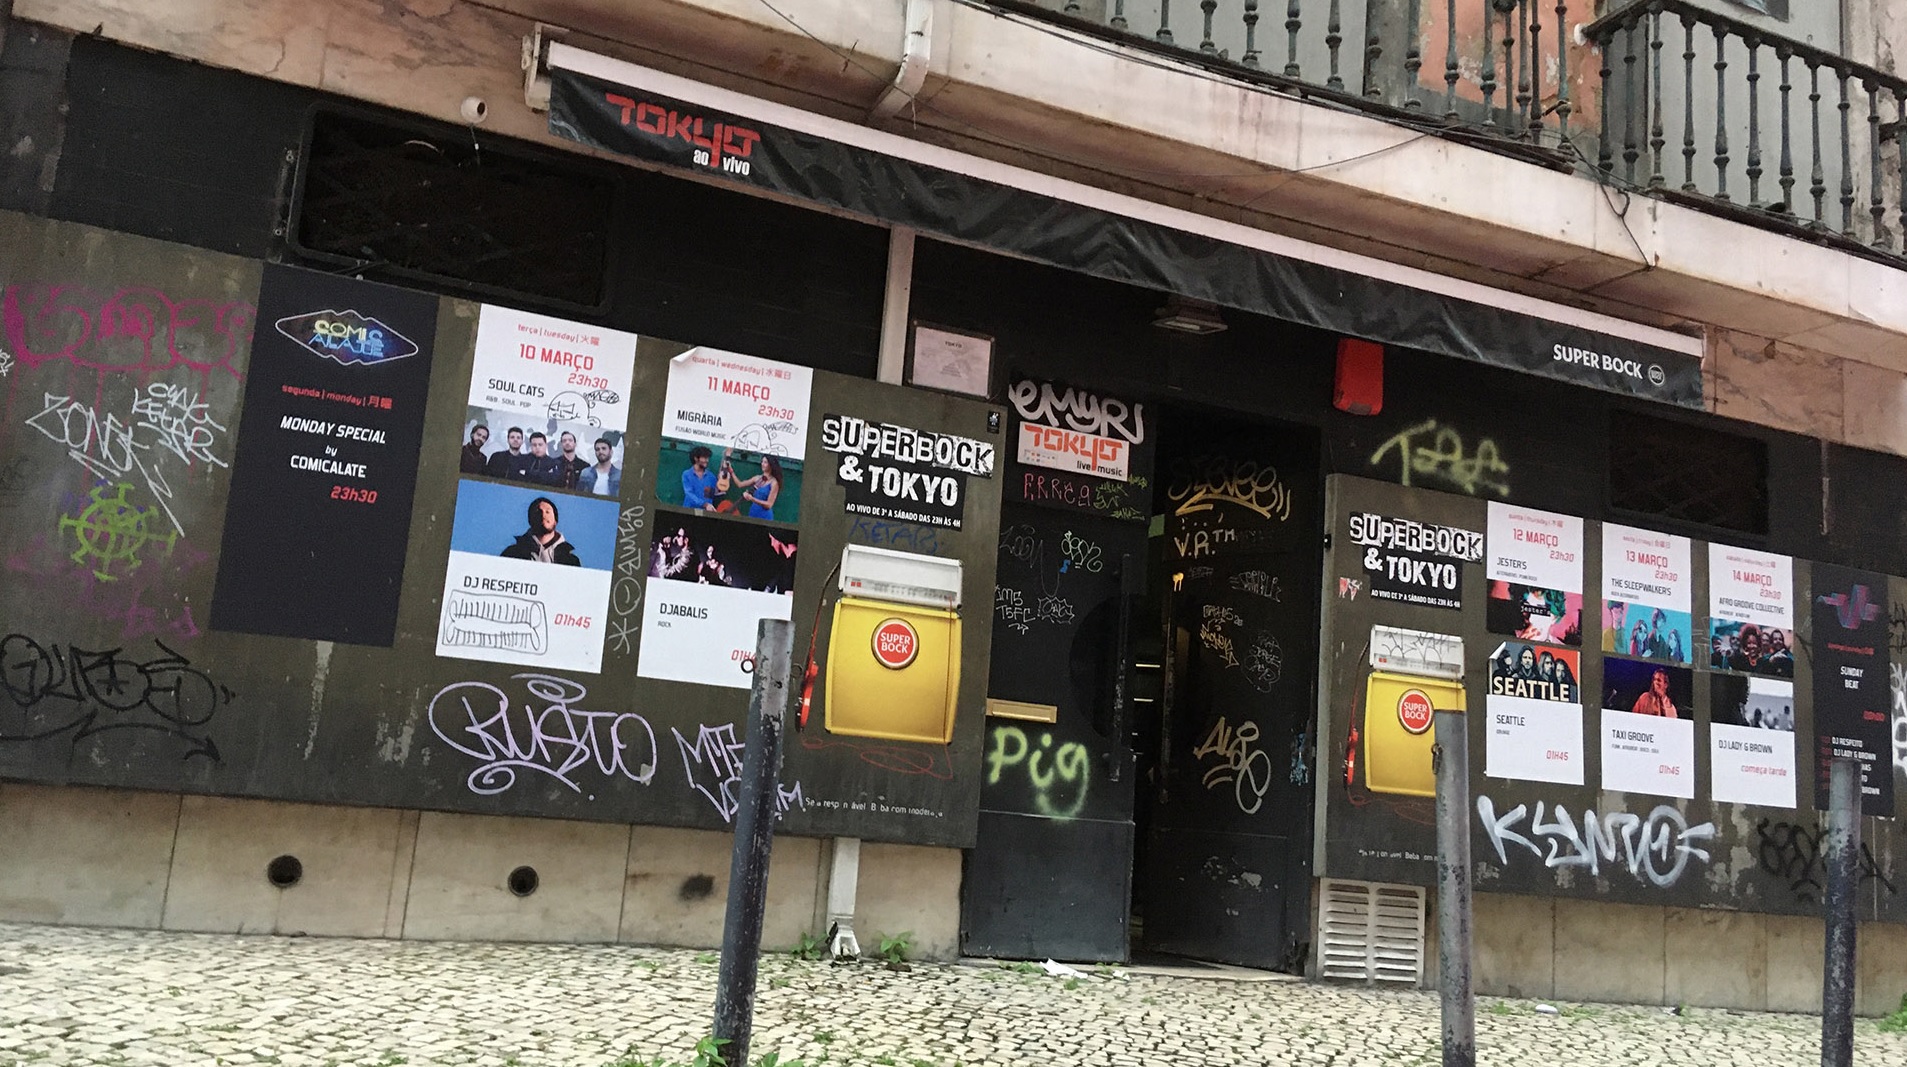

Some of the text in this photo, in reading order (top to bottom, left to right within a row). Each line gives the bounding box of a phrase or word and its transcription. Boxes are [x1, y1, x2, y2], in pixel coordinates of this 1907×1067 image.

[605, 92, 761, 168] TOKYO
[693, 149, 750, 176] ao vivo
[517, 323, 576, 344] terça tuesday
[519, 342, 594, 372] 10 MARÇO
[1553, 343, 1600, 369] SUPER
[1602, 354, 1643, 379] BOCK
[721, 362, 761, 376] wednesday
[488, 378, 545, 398] SOUL CATS
[567, 372, 609, 390] 23h30
[707, 376, 770, 402] 11 MARÇO
[326, 392, 362, 406] monday
[758, 404, 795, 421] 23h30
[280, 415, 386, 444] MONDAY SPECIAL
[325, 445, 338, 457] by
[1024, 424, 1123, 471] TOKYO
[290, 454, 367, 478] COMICALATE
[1076, 460, 1122, 477] live music
[838, 454, 958, 507] & TOKYO
[330, 485, 378, 504] 23h30
[846, 502, 856, 512] AO
[856, 504, 871, 514] VIVO
[872, 506, 881, 515] DE
[888, 509, 893, 518] A
[893, 509, 918, 521] SÁBADO
[918, 513, 931, 523] DAS
[931, 515, 943, 525] 23H
[952, 519, 961, 528] 4H
[1513, 528, 1559, 548] 12 MARÇO
[1549, 550, 1574, 563] 23h30
[1626, 549, 1668, 569] 13 MARÇO
[1363, 547, 1456, 590] & TOKYO
[1654, 570, 1678, 582] 23h30
[463, 575, 538, 596] DJ RESPEITO
[1611, 578, 1623, 588] THE
[1732, 569, 1772, 587] 14 MARÇO
[1760, 588, 1782, 600] 23h30
[659, 602, 708, 619] DJABALIS
[1719, 597, 1733, 607] AFRO
[1734, 599, 1754, 610] GROOVE
[1755, 602, 1785, 614] COLLECTIVE
[554, 613, 592, 628] 01h45
[657, 620, 671, 628] ROCK
[880, 632, 911, 654] SUPER BOCK
[1840, 665, 1864, 678] SUNDAY
[1493, 676, 1570, 702] SEATTLE
[1844, 679, 1859, 690] BEAT
[1403, 701, 1427, 720] SUPER BOCK
[1496, 714, 1526, 726] SEATTLE
[1612, 729, 1654, 743] TAXI GROOVE
[1718, 739, 1726, 749] DJ
[1728, 740, 1743, 751] LADY
[1749, 743, 1773, 754] BROWN
[870, 803, 889, 812] Bba
